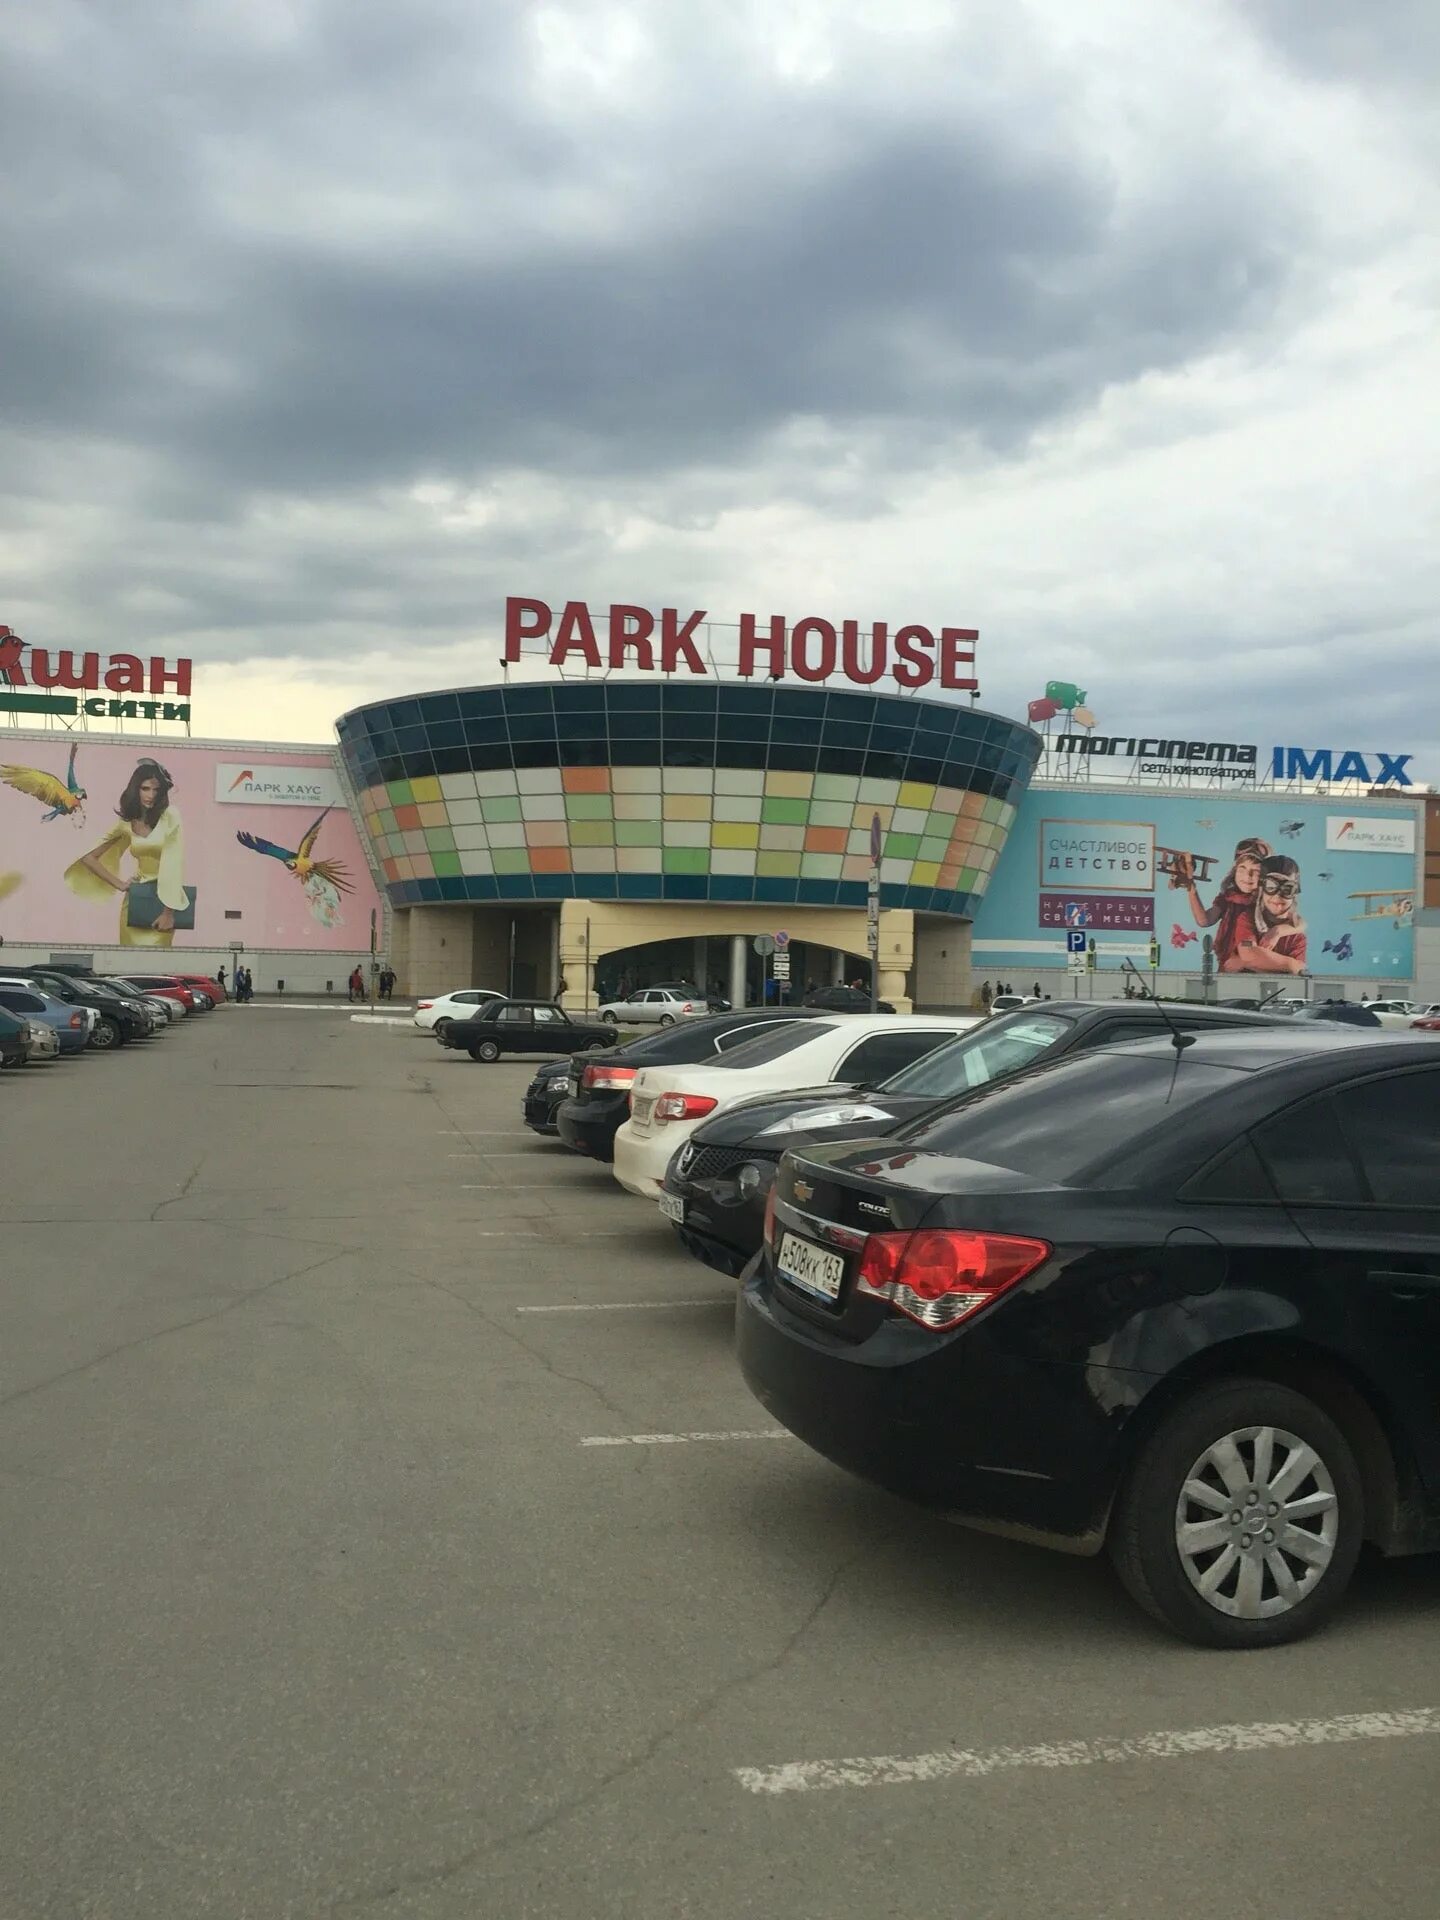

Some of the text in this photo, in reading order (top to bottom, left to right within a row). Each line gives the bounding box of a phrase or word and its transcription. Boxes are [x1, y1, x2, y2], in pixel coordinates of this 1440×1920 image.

[505, 597, 979, 690] PARK HOUSE
[1141, 763, 1256, 780] сеть кинотеатров
[1272, 746, 1413, 786] IMAX
[244, 783, 321, 795] ПАРК ХАУС
[1050, 839, 1147, 855] СЧАСТЛИВОЕ
[1049, 857, 1147, 872] ДЕТСТВО
[1043, 901, 1150, 913] НАСТРЕЧУ
[1043, 913, 1151, 925] СВЙ МЕЧТЕ
[1071, 933, 1083, 951] P
[823, 1255, 841, 1283] 163
